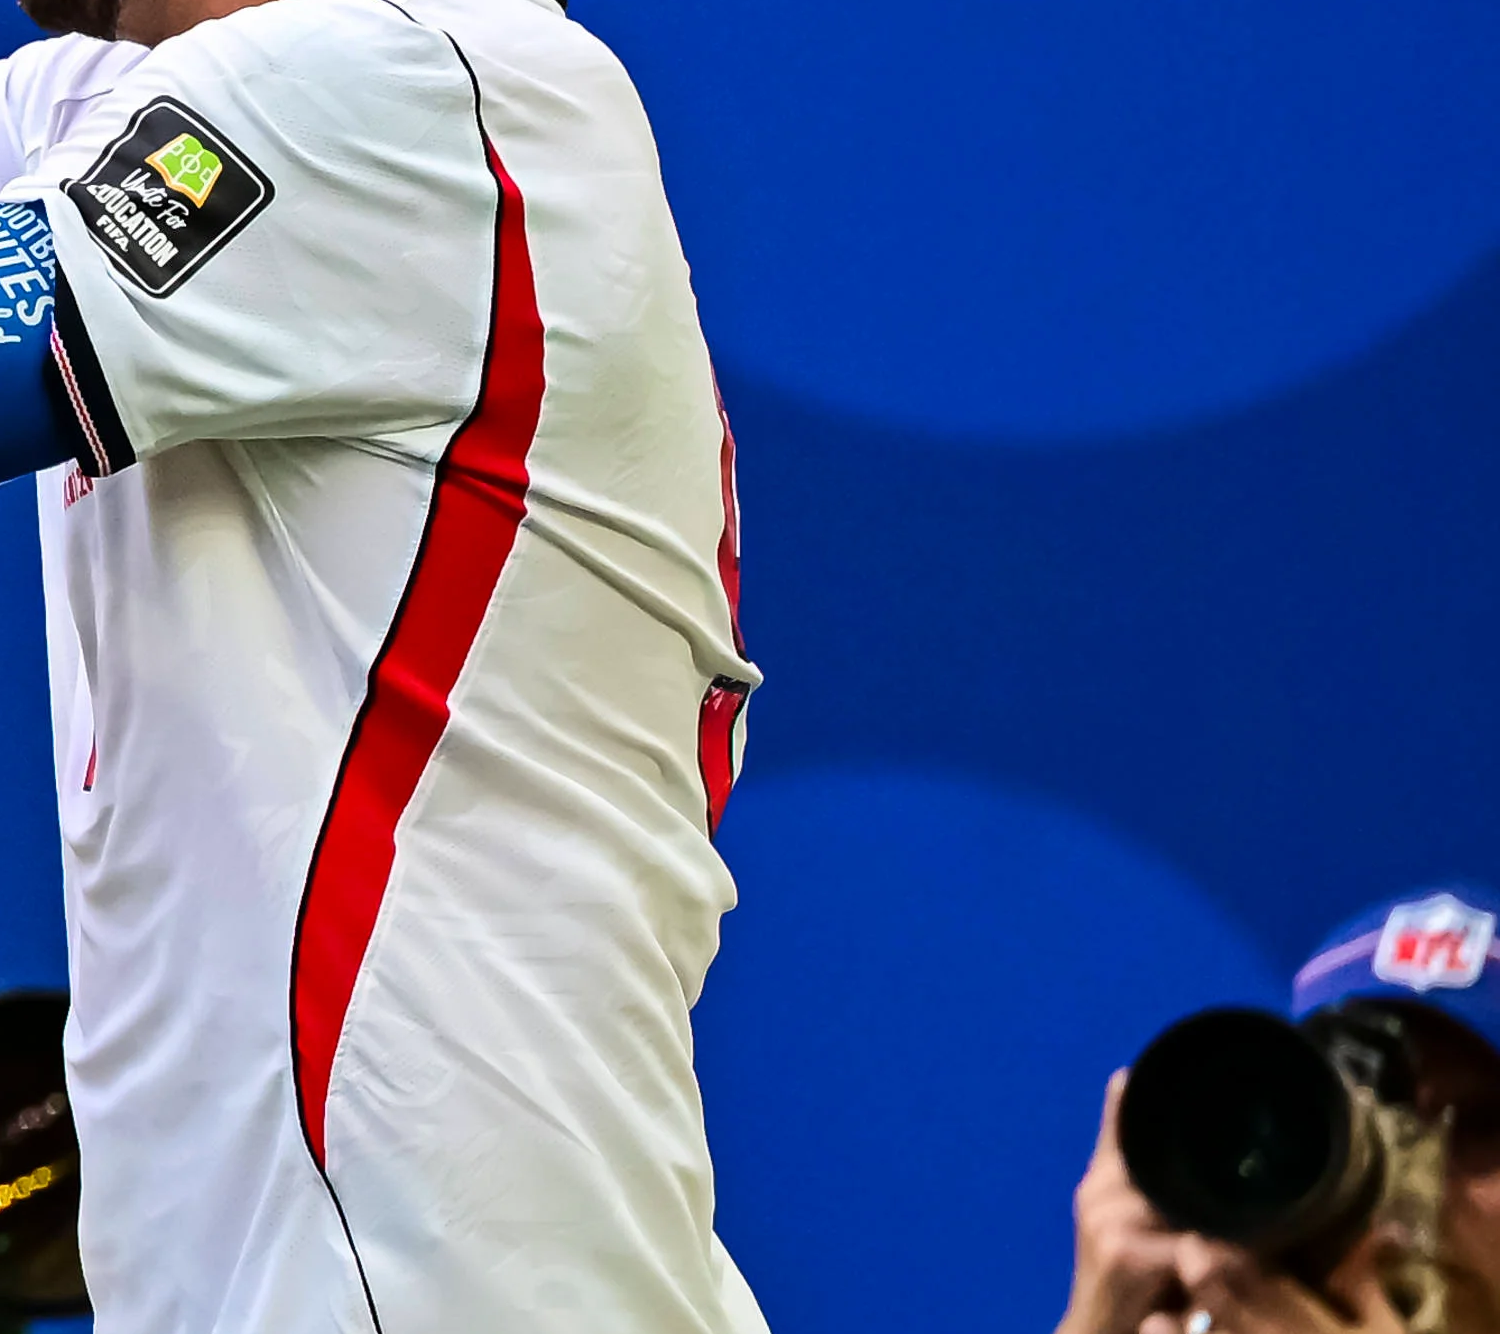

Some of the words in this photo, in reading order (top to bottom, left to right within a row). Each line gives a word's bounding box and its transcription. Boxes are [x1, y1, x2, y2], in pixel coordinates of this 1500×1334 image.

[86, 183, 179, 268] EDUCATION
[96, 214, 129, 253] FIFA
[156, 199, 190, 229] For
